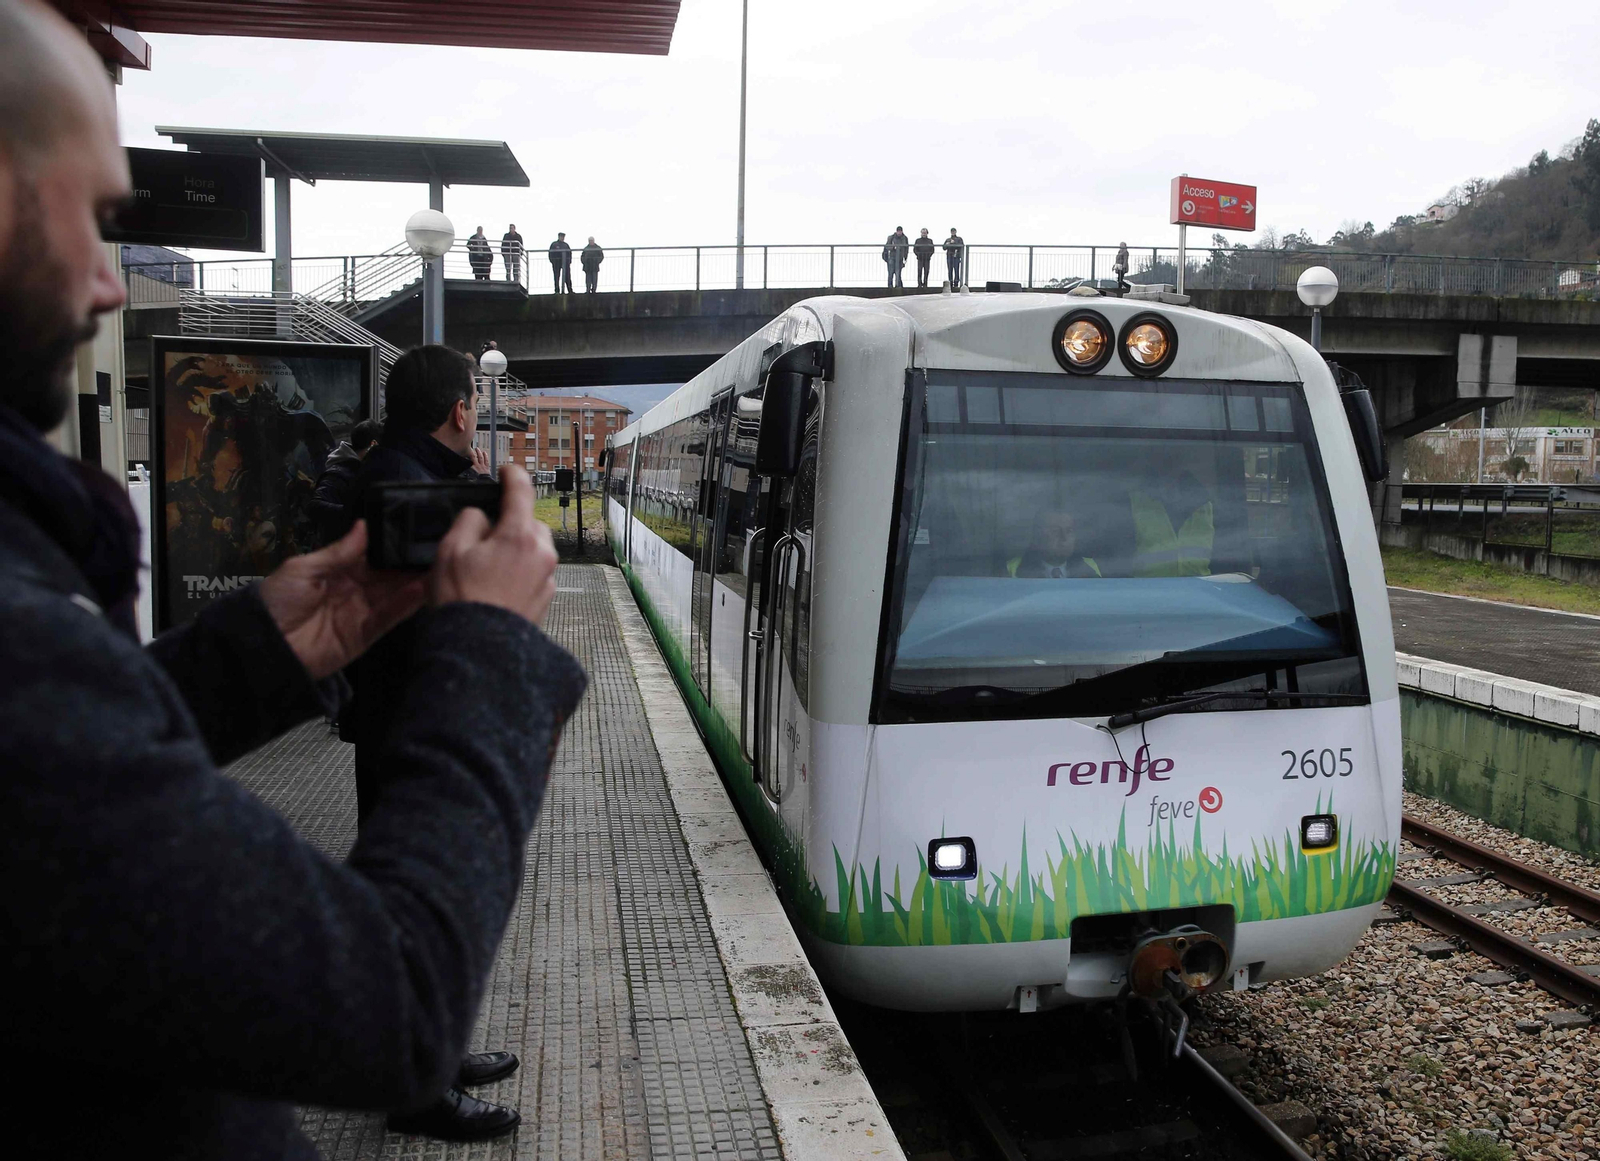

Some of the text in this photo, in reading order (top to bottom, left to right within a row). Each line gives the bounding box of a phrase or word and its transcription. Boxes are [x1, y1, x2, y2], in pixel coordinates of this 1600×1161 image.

[184, 176, 215, 188] Hora
[184, 190, 216, 203] Time
[1182, 184, 1215, 199] Acceso
[784, 718, 801, 753] renfe
[1046, 743, 1175, 797] renfe
[1281, 747, 1354, 780] 2605
[1147, 795, 1194, 827] feve
